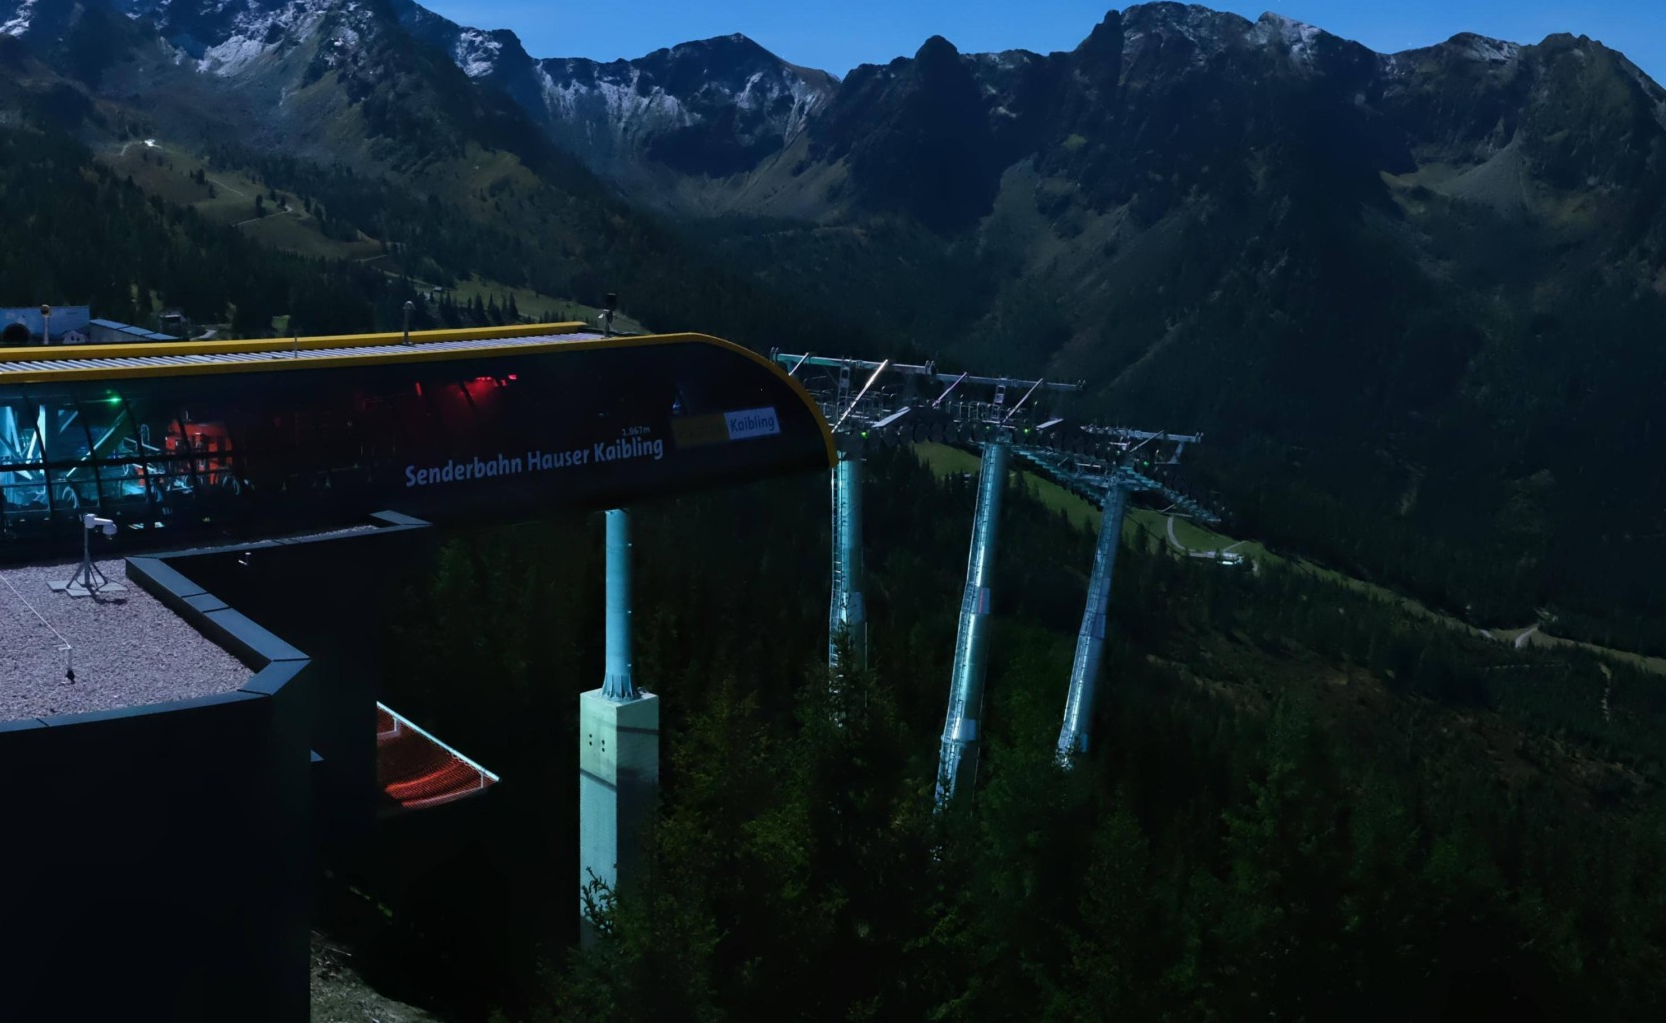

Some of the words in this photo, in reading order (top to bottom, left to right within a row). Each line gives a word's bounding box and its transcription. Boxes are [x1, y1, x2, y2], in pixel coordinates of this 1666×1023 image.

[731, 415, 775, 432] Kaibling
[405, 453, 523, 488] Senderbahn
[527, 446, 590, 472] Hauser
[593, 438, 664, 463] Kaibling
